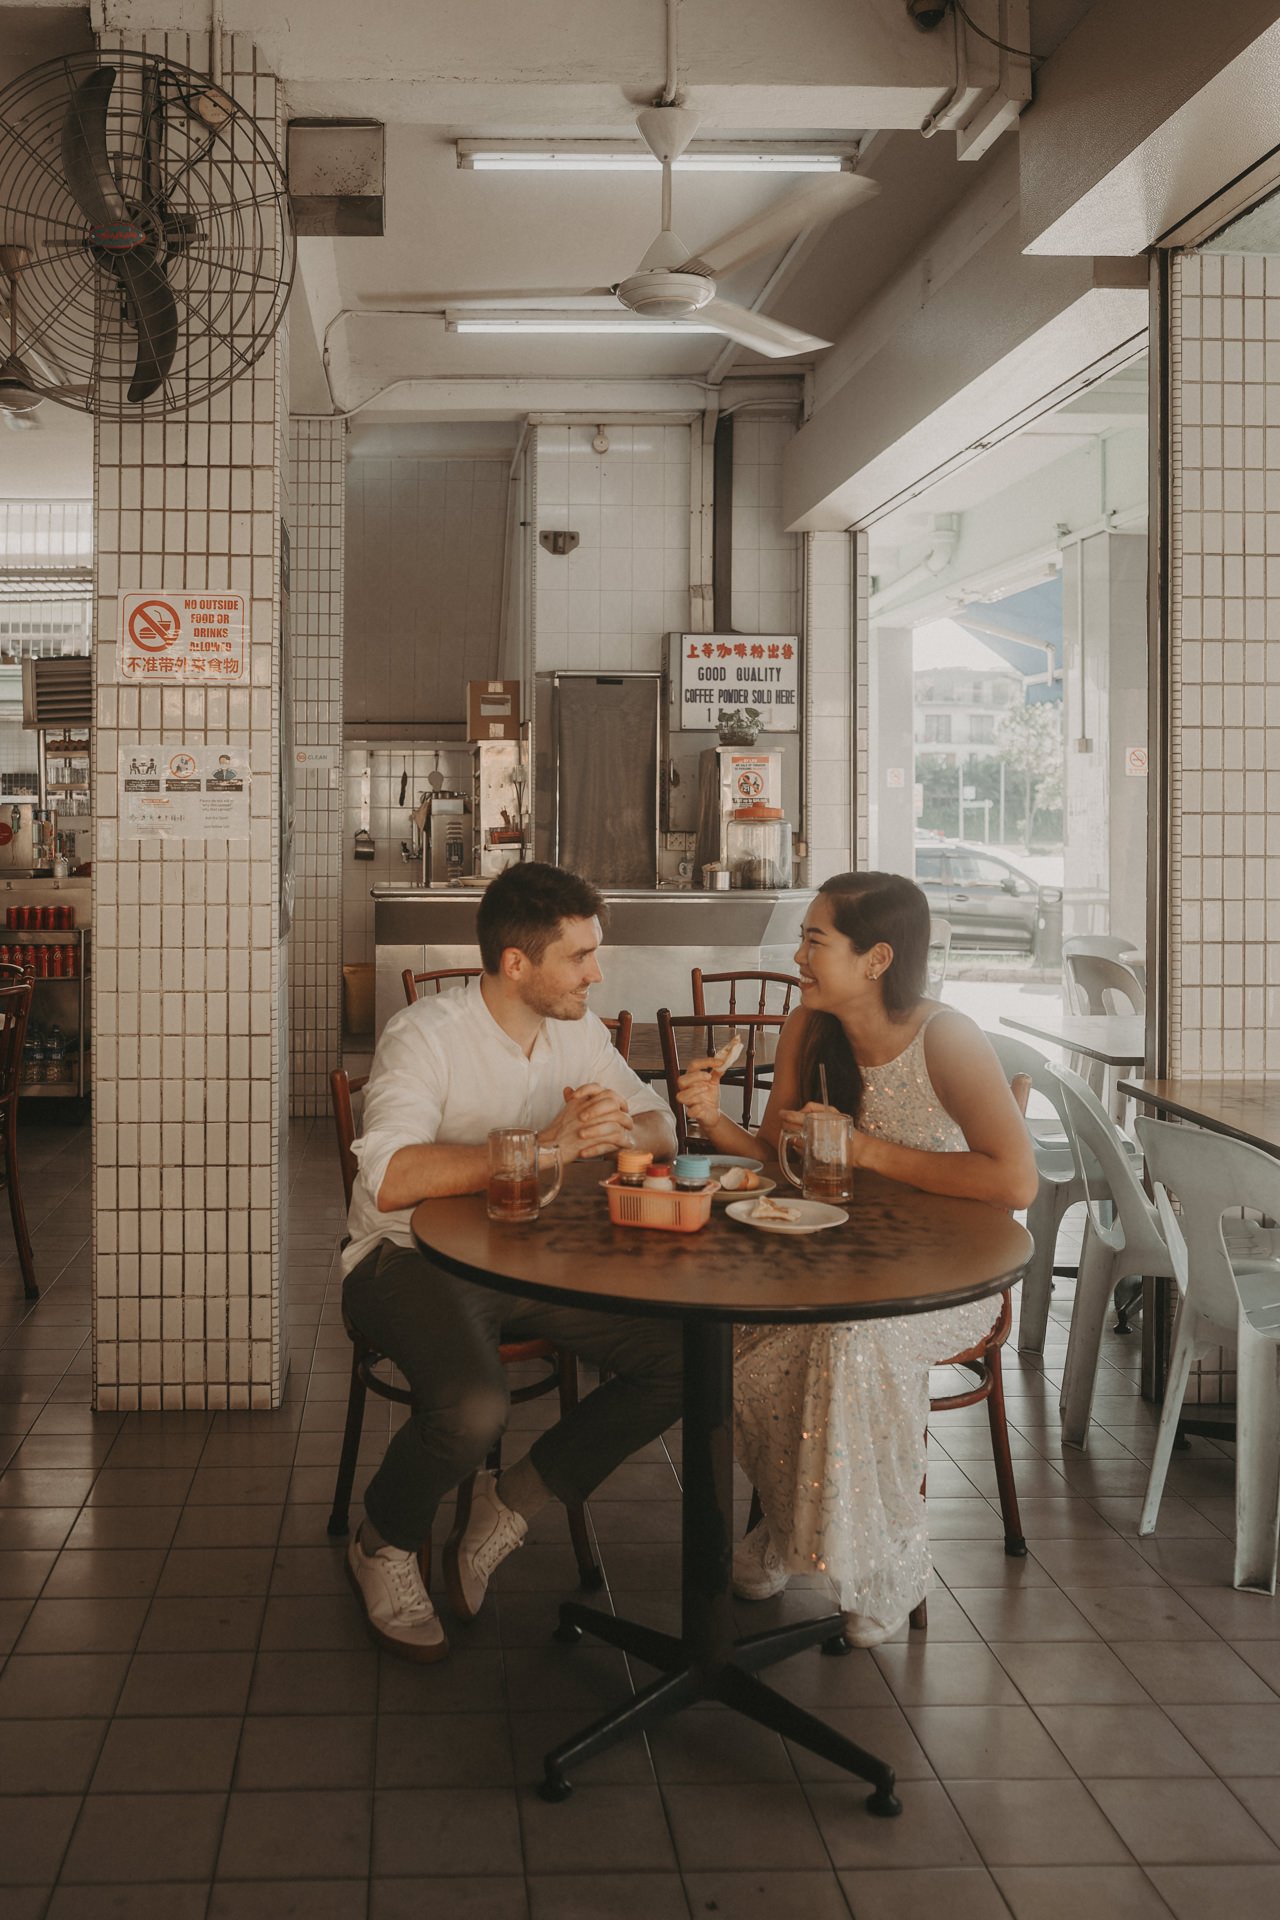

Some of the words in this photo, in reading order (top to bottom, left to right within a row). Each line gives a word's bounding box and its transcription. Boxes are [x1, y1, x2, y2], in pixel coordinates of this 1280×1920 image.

[184, 599, 197, 610] NO
[199, 599, 239, 610] OUTSIDE
[190, 613, 215, 624] FOOD
[216, 613, 230, 625] OR
[193, 627, 229, 638] DRINKS
[697, 666, 727, 682] GOOD
[736, 667, 782, 682] QUALITY
[684, 688, 715, 704] COFFEE
[718, 688, 749, 704] POWDER
[752, 689, 772, 704] SOLD
[775, 689, 796, 705] HERE
